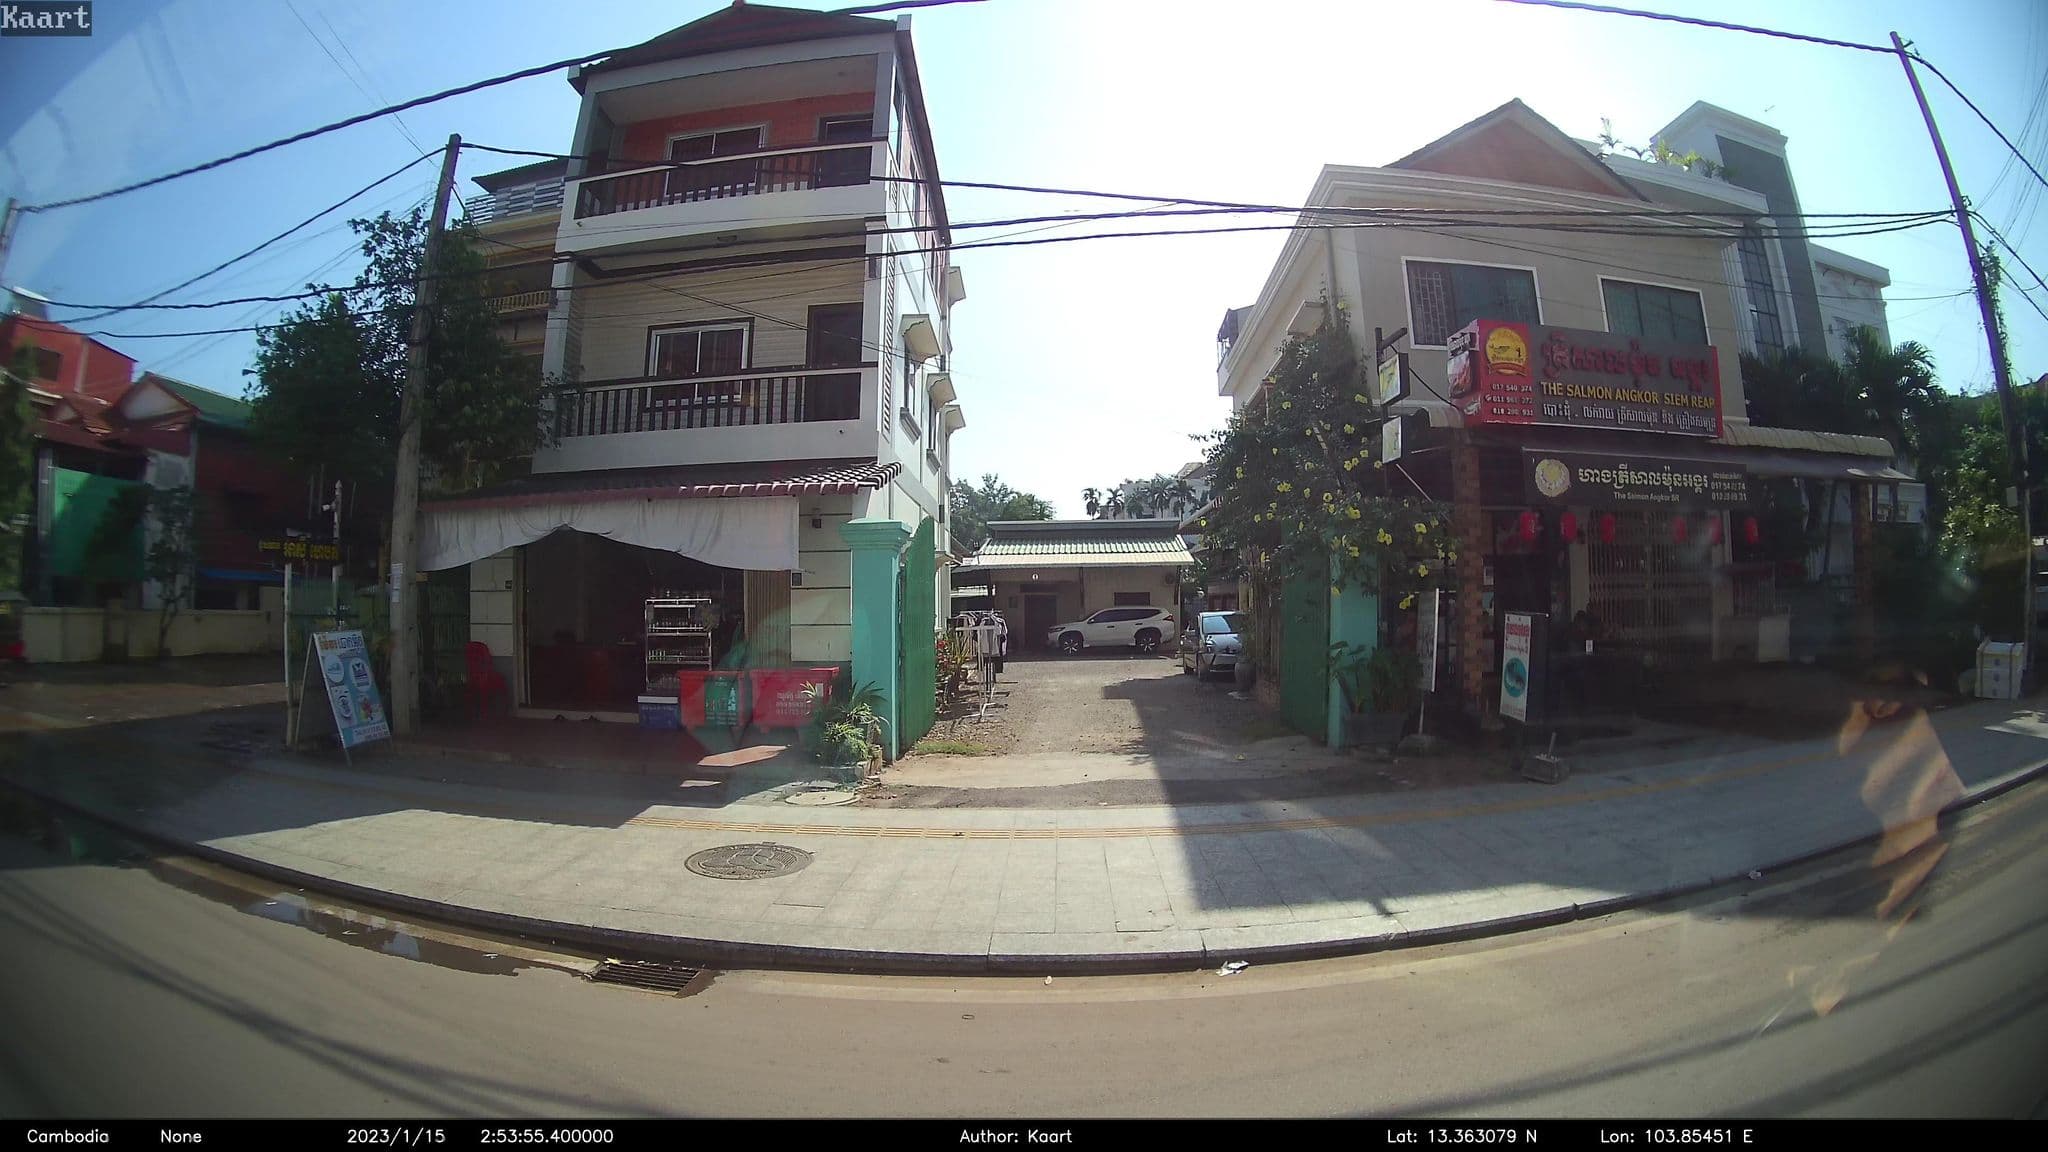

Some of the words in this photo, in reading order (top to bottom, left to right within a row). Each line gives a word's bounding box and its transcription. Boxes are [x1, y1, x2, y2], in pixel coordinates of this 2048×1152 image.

[1541, 381, 1564, 396] THE
[1567, 384, 1613, 401] SALMON
[1615, 387, 1660, 405] ANGKOR
[1664, 393, 1689, 407] SIEM
[1691, 396, 1716, 409] REAP
[1614, 492, 1627, 500] The
